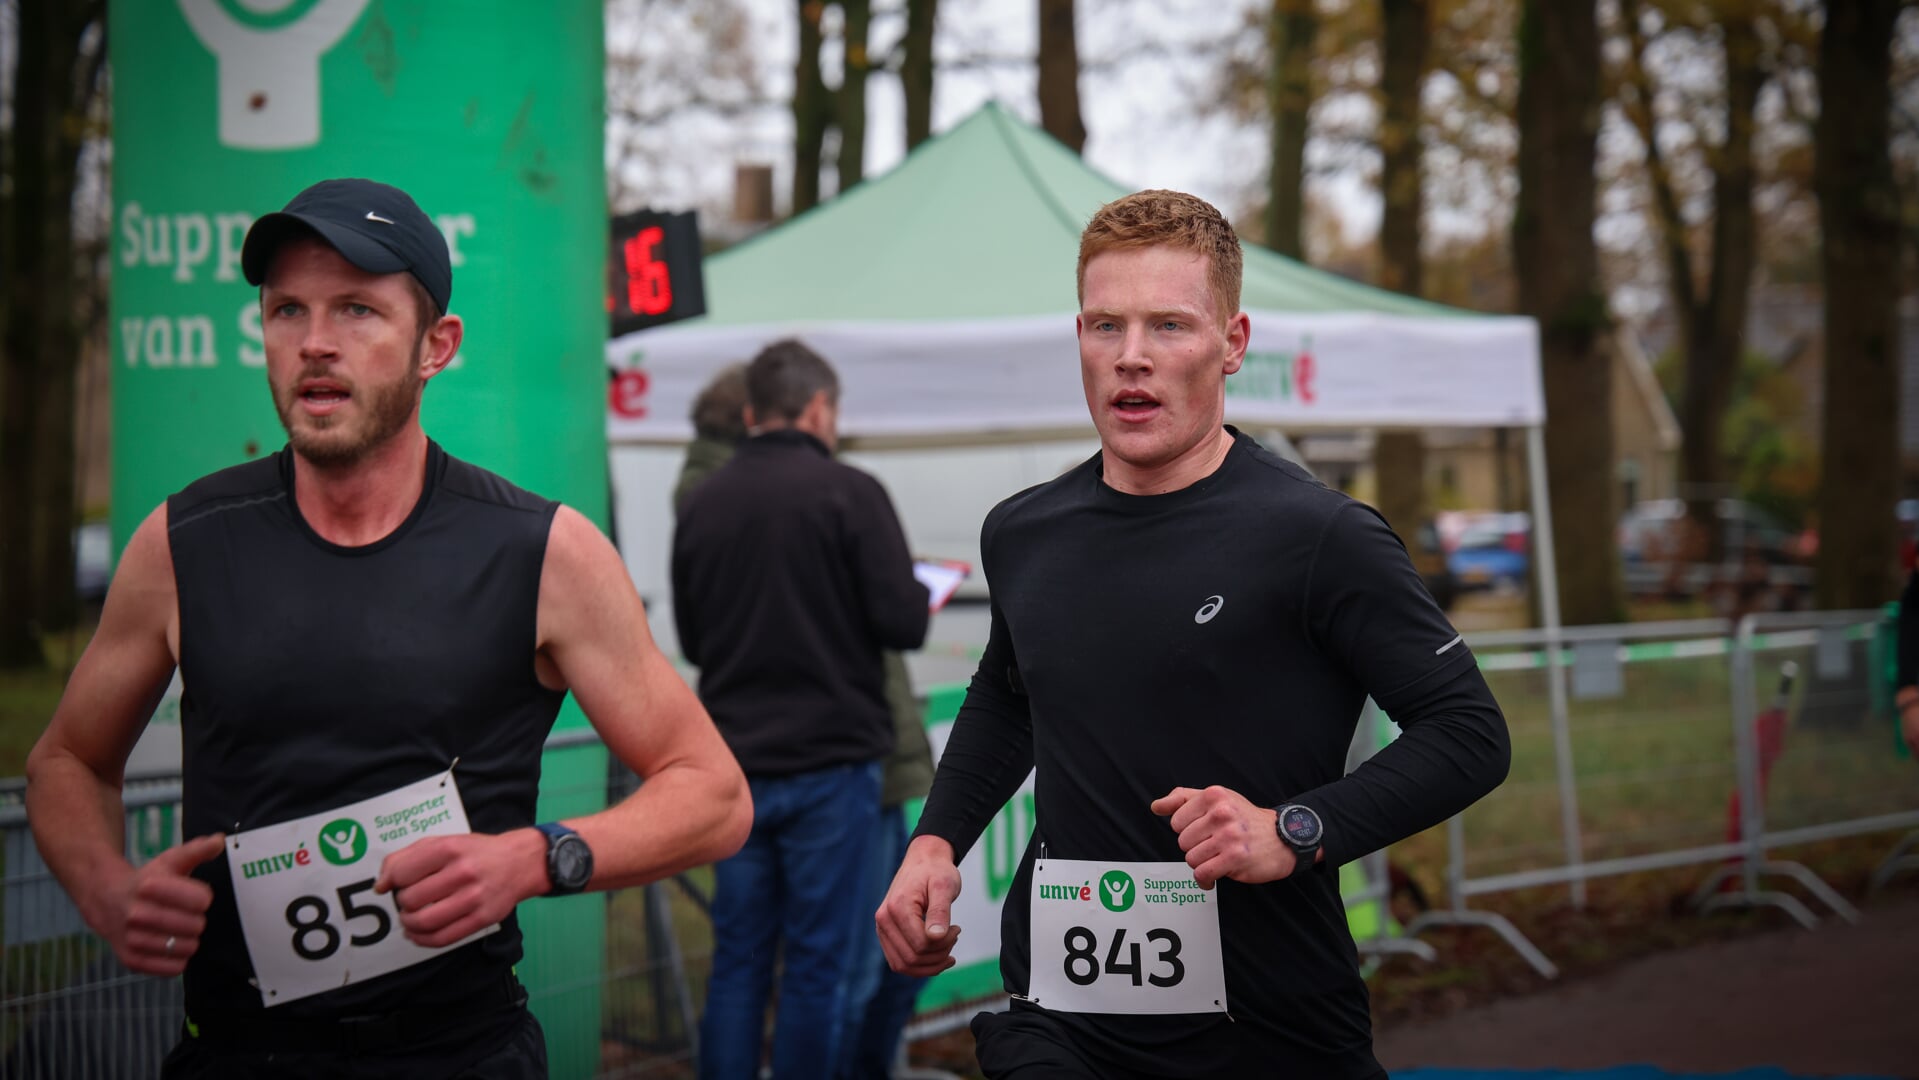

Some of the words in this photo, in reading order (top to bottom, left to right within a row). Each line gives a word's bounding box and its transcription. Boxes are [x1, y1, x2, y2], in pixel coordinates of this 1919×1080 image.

[121, 314, 218, 370] van
[374, 794, 446, 830] Supporter
[379, 827, 408, 843] van
[410, 809, 452, 834] Sport
[241, 841, 312, 880] univé
[1039, 880, 1092, 901] univé
[1143, 878, 1200, 892] Supporte
[1144, 893, 1170, 904] van
[1170, 892, 1207, 906] Sport
[285, 876, 403, 962] 85
[1063, 925, 1185, 989] 843
